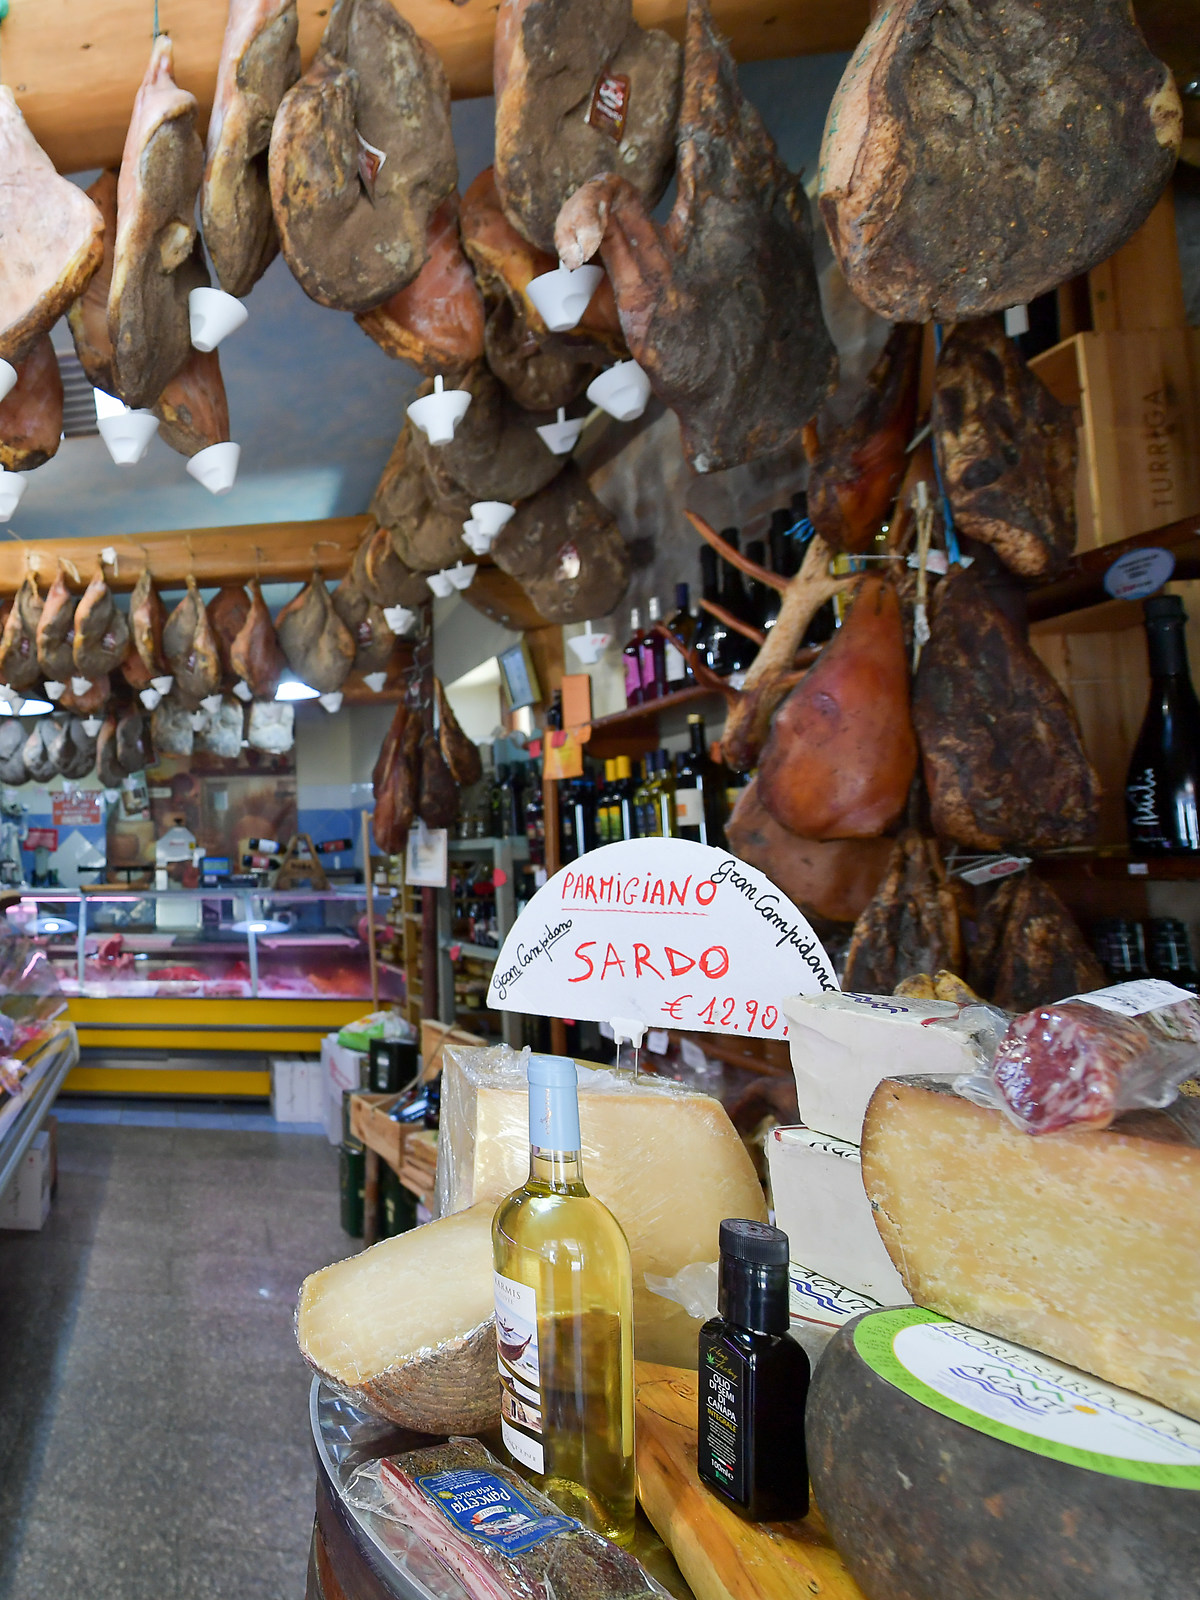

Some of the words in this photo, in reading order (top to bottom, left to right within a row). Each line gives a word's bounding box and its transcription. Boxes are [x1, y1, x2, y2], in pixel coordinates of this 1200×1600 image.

[1144, 388, 1175, 509] TURRIGA
[561, 871, 718, 907] PARMIGIANO
[567, 941, 730, 982] SARDO
[660, 995, 693, 1020] €
[940, 1324, 1028, 1364] FIORE
[709, 1378, 718, 1391] DI
[717, 1385, 735, 1404] SEMI
[712, 1373, 731, 1391] OLIO
[707, 1395, 737, 1423] CANAPA
[717, 1394, 726, 1406] DI
[707, 1407, 737, 1434] INTEGRALE
[450, 1487, 511, 1514] PANCETTA
